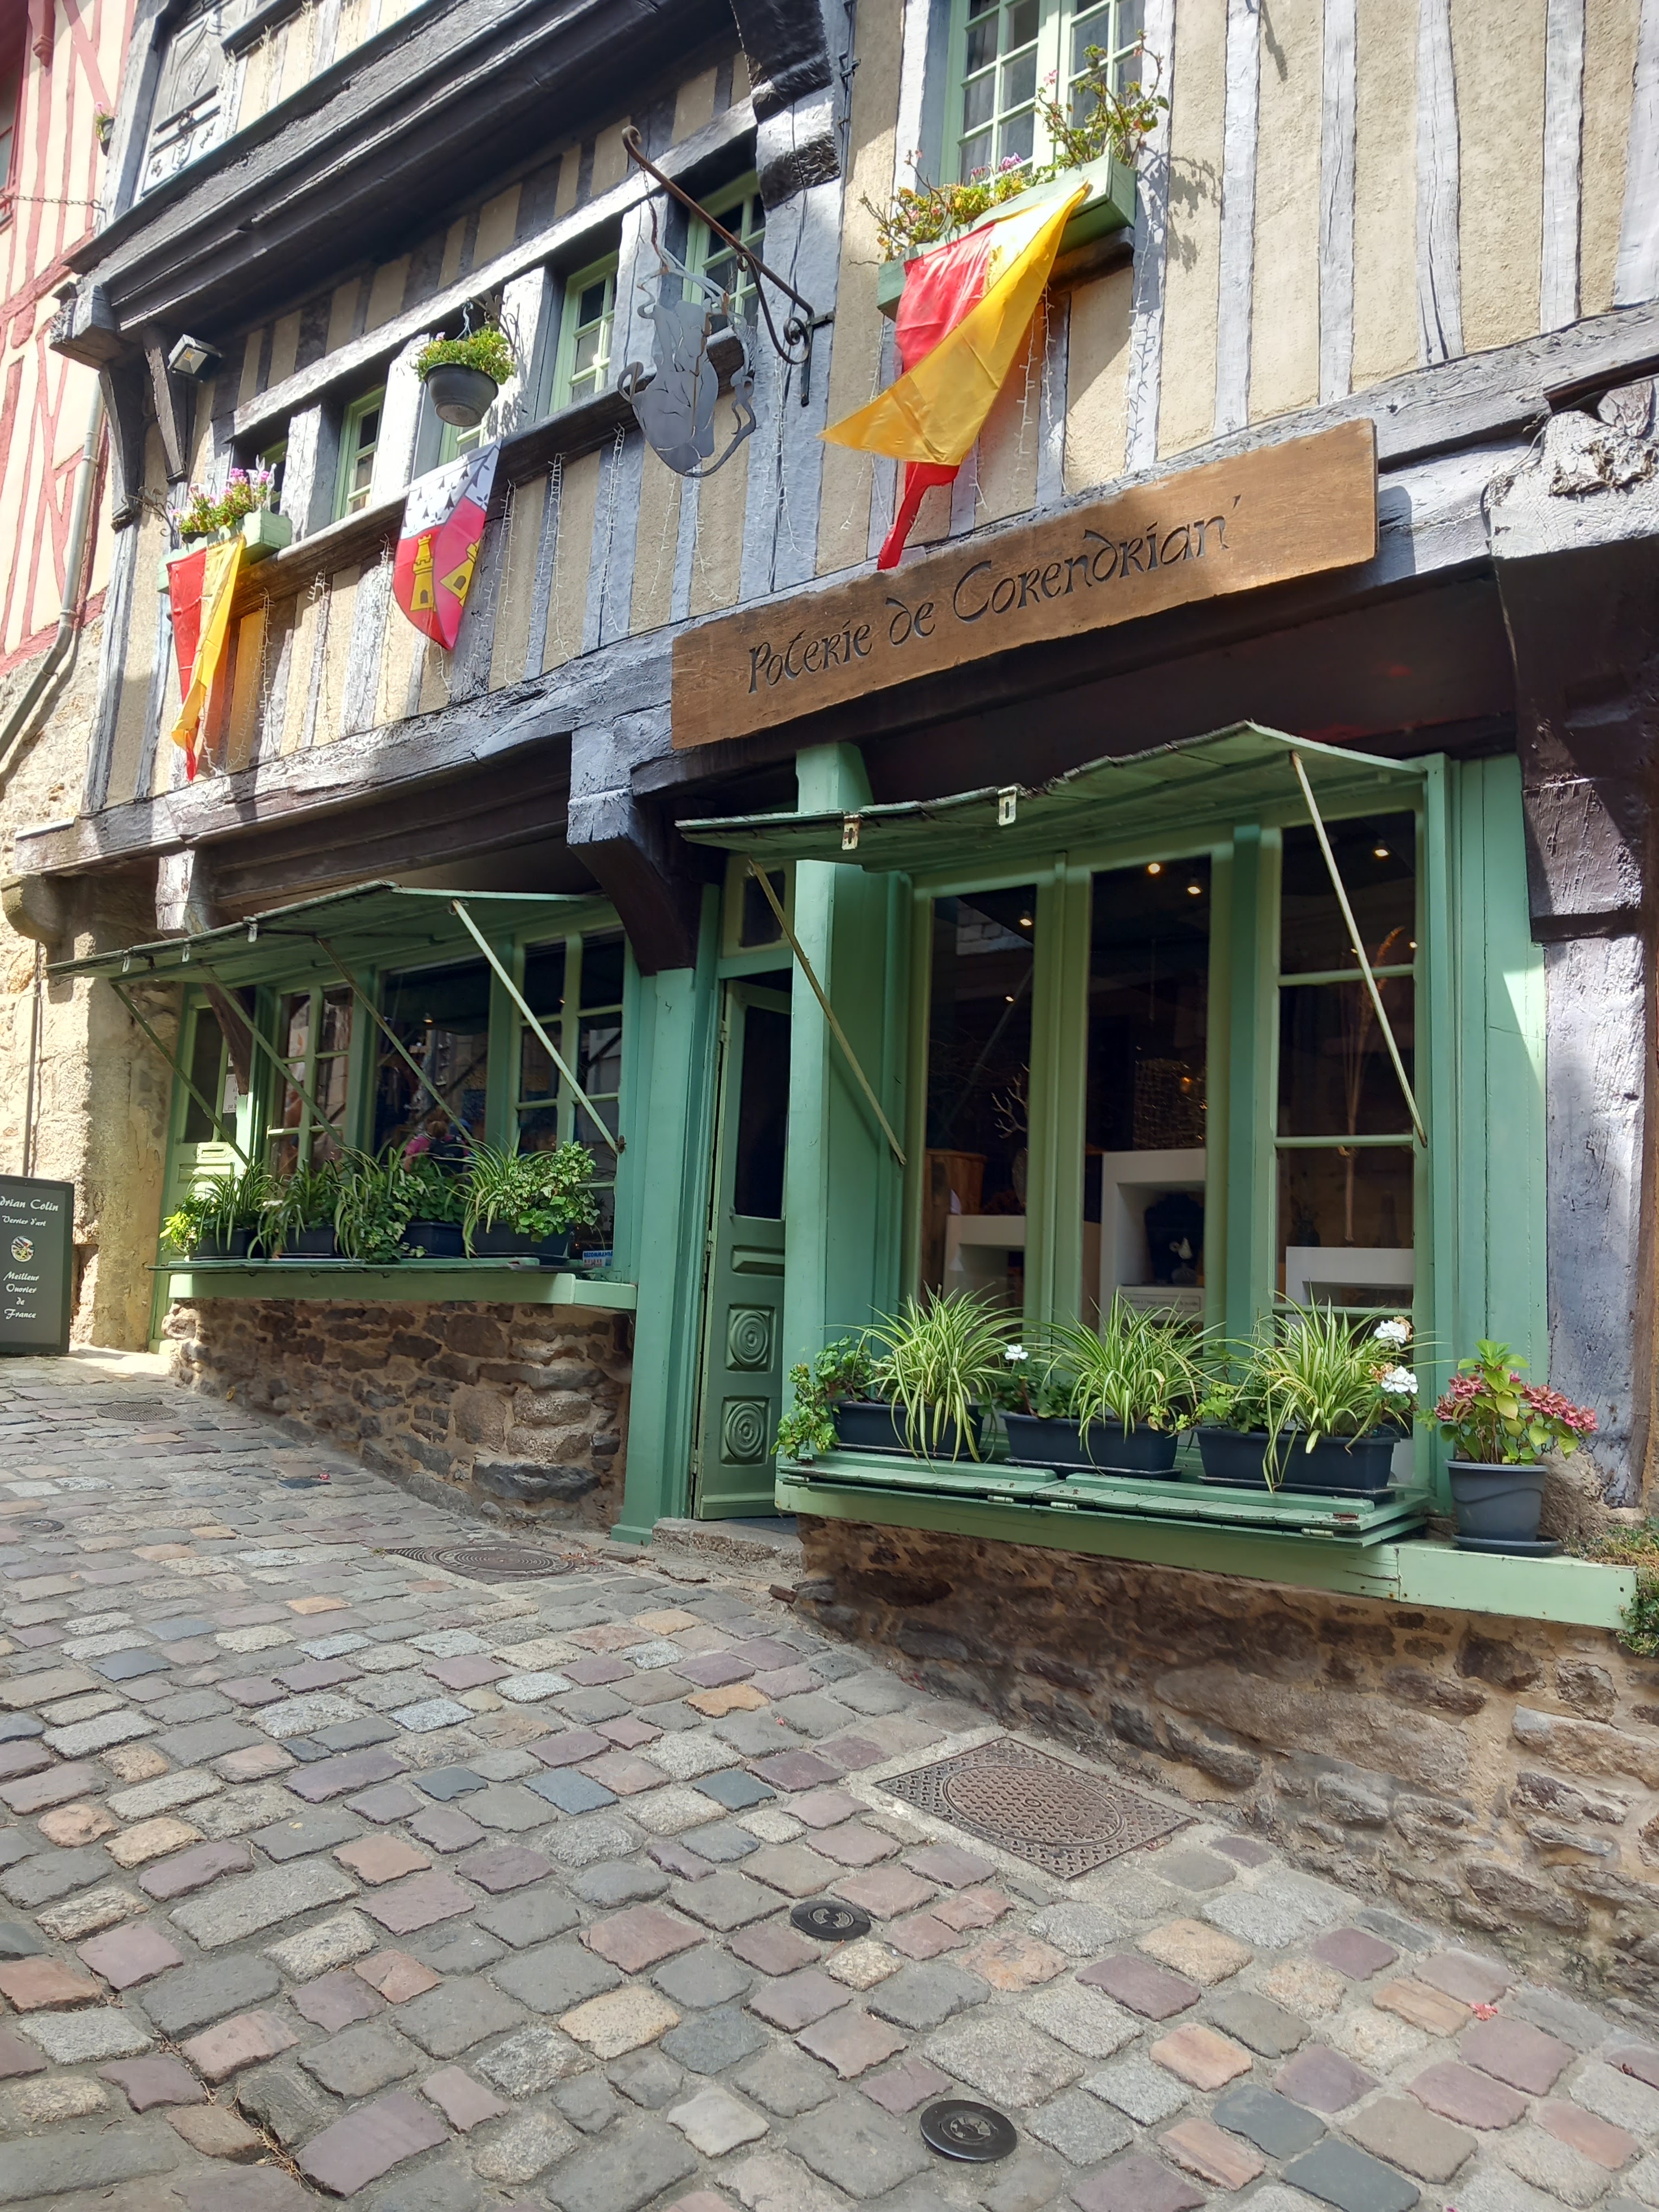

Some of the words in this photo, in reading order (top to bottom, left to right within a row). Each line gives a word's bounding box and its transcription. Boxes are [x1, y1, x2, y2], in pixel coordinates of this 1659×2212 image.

[748, 620, 872, 694] Poterie
[885, 597, 936, 646] de
[30, 1199, 59, 1211] Colin
[30, 1218, 46, 1226] d'art
[3, 1271, 39, 1281] Meilleur
[6, 1283, 37, 1294] Ouvrier
[16, 1296, 25, 1305] de
[4, 1308, 36, 1320] France
